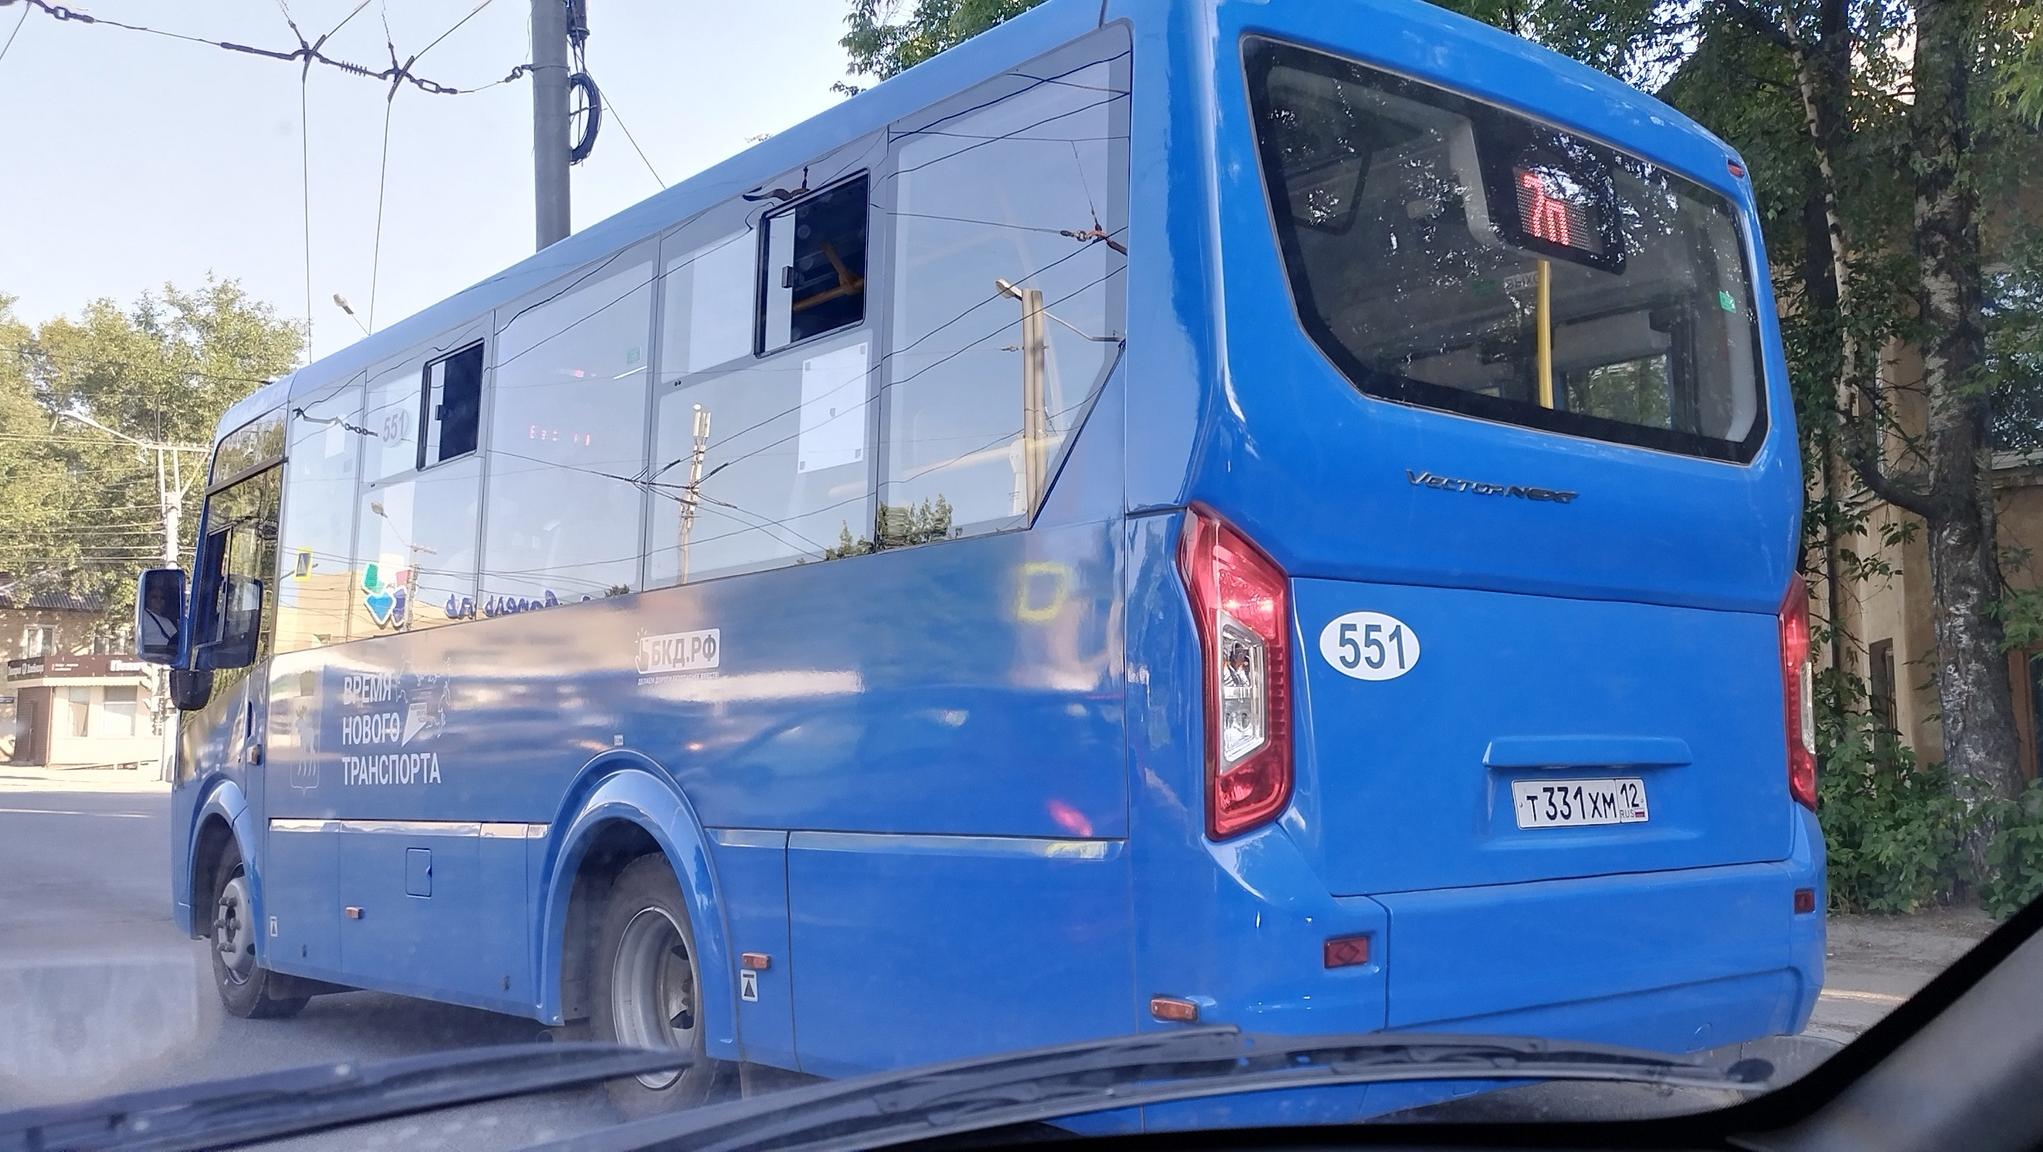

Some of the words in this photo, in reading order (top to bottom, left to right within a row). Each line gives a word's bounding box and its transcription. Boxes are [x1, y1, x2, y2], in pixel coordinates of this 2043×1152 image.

[382, 409, 405, 442] 551
[650, 633, 718, 668] БКД.РФ
[1338, 622, 1407, 670] 551
[343, 674, 392, 706] ВРЕМЯ
[342, 712, 401, 746] НОВОГО
[341, 752, 442, 786] ТРАНСПОРТА
[1619, 782, 1641, 809] 12
[1619, 809, 1635, 819] RUS
